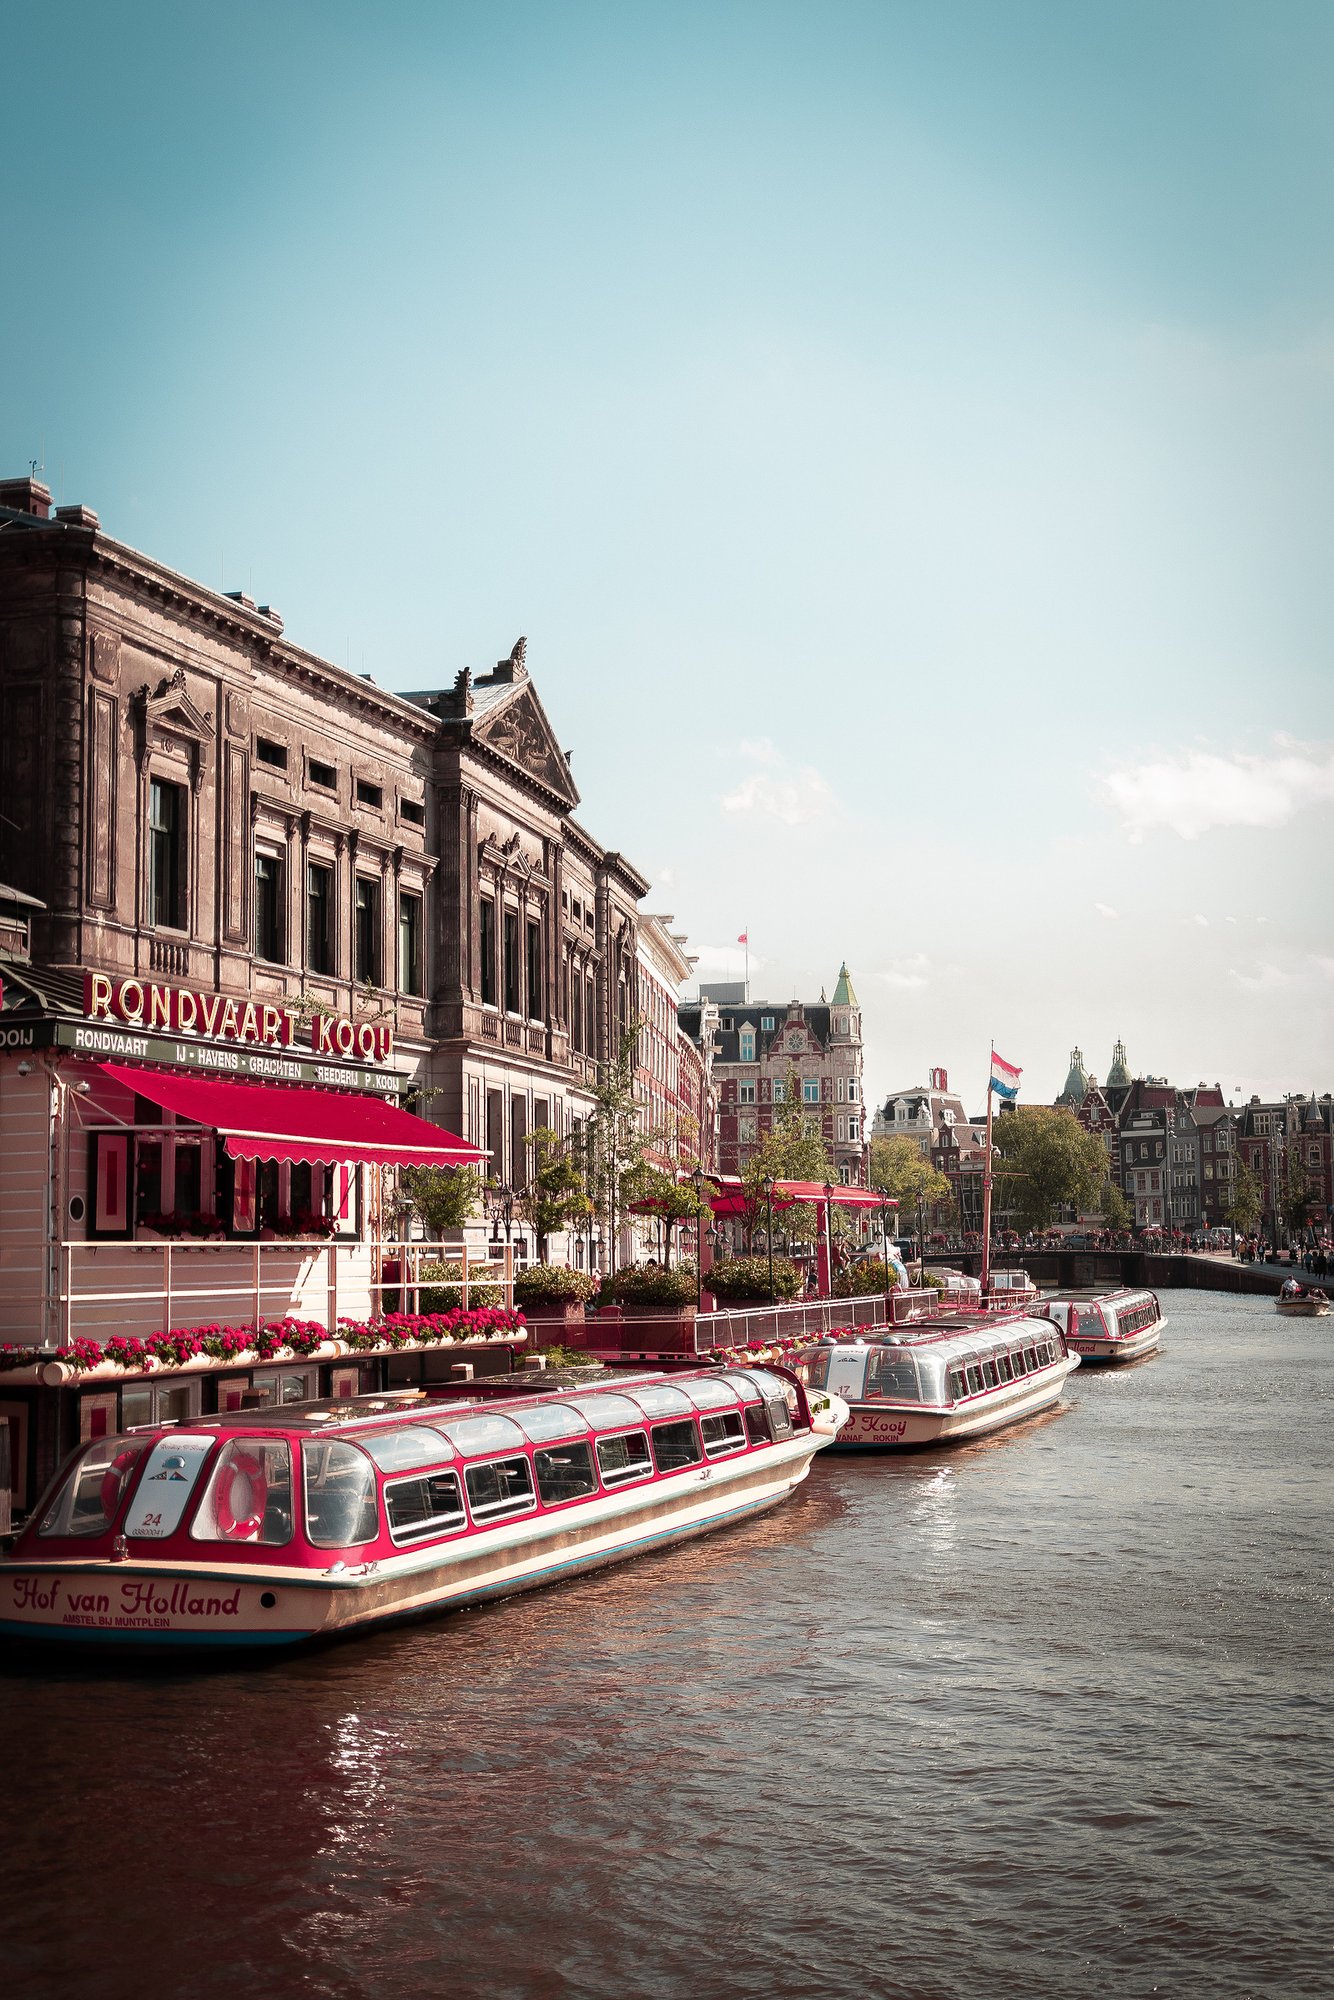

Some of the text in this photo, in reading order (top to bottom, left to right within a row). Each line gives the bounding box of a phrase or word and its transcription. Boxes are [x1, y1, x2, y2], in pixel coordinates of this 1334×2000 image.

[90, 973, 299, 1046] RONDVAART
[75, 1028, 149, 1056] RONDVAART
[176, 1045, 186, 1062] IJ
[198, 1049, 238, 1070] HAVENS
[249, 1057, 301, 1078] GRACHTEN
[316, 1066, 358, 1086] REEDERIJ
[839, 1385, 850, 1393] 17
[142, 1513, 162, 1526] 24
[13, 1578, 241, 1616] Hof van Holland
[63, 1614, 170, 1627] AMSTEL BIJ MUNTPLEIN
